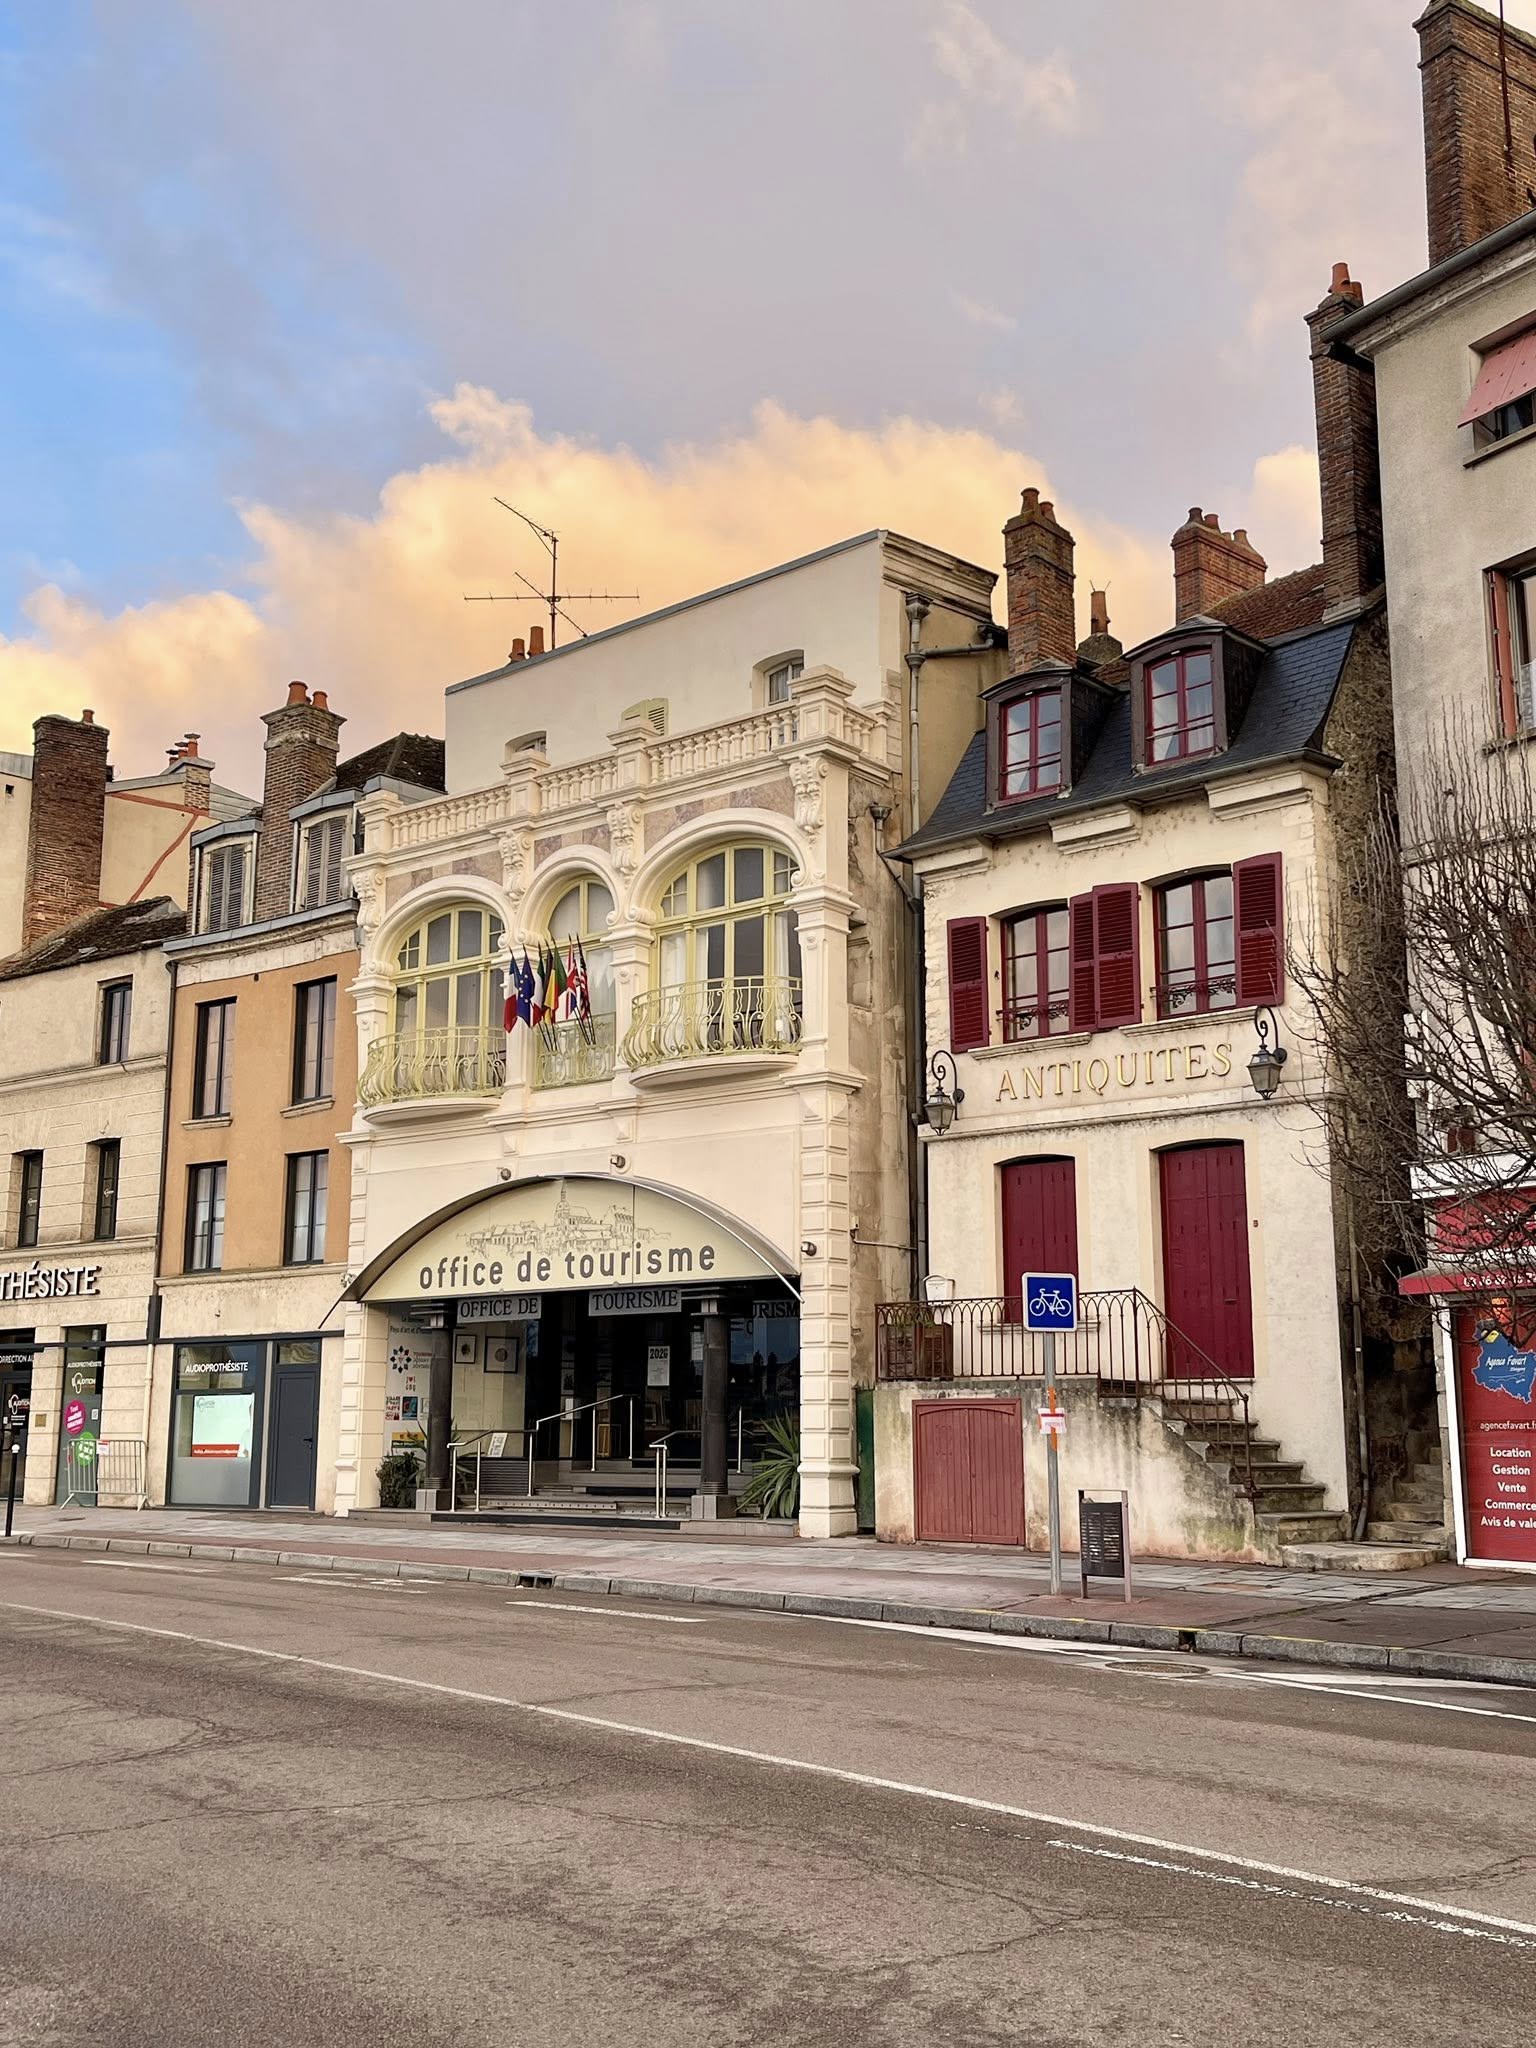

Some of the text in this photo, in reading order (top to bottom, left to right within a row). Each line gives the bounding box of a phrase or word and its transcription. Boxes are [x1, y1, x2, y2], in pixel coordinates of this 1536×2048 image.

[996, 1043, 1233, 1102] ANTIQUITES
[419, 1242, 716, 1290] office de tourisme
[460, 1289, 678, 1318] OFFICE DE TOURISME
[185, 1360, 249, 1373] AUDIOPROTHÉSISTE
[1490, 1447, 1531, 1458] Location
[1492, 1464, 1530, 1475] Gestion
[1497, 1482, 1527, 1493] Vente
[1480, 1516, 1501, 1527] Avis
[1503, 1517, 1516, 1527] de
